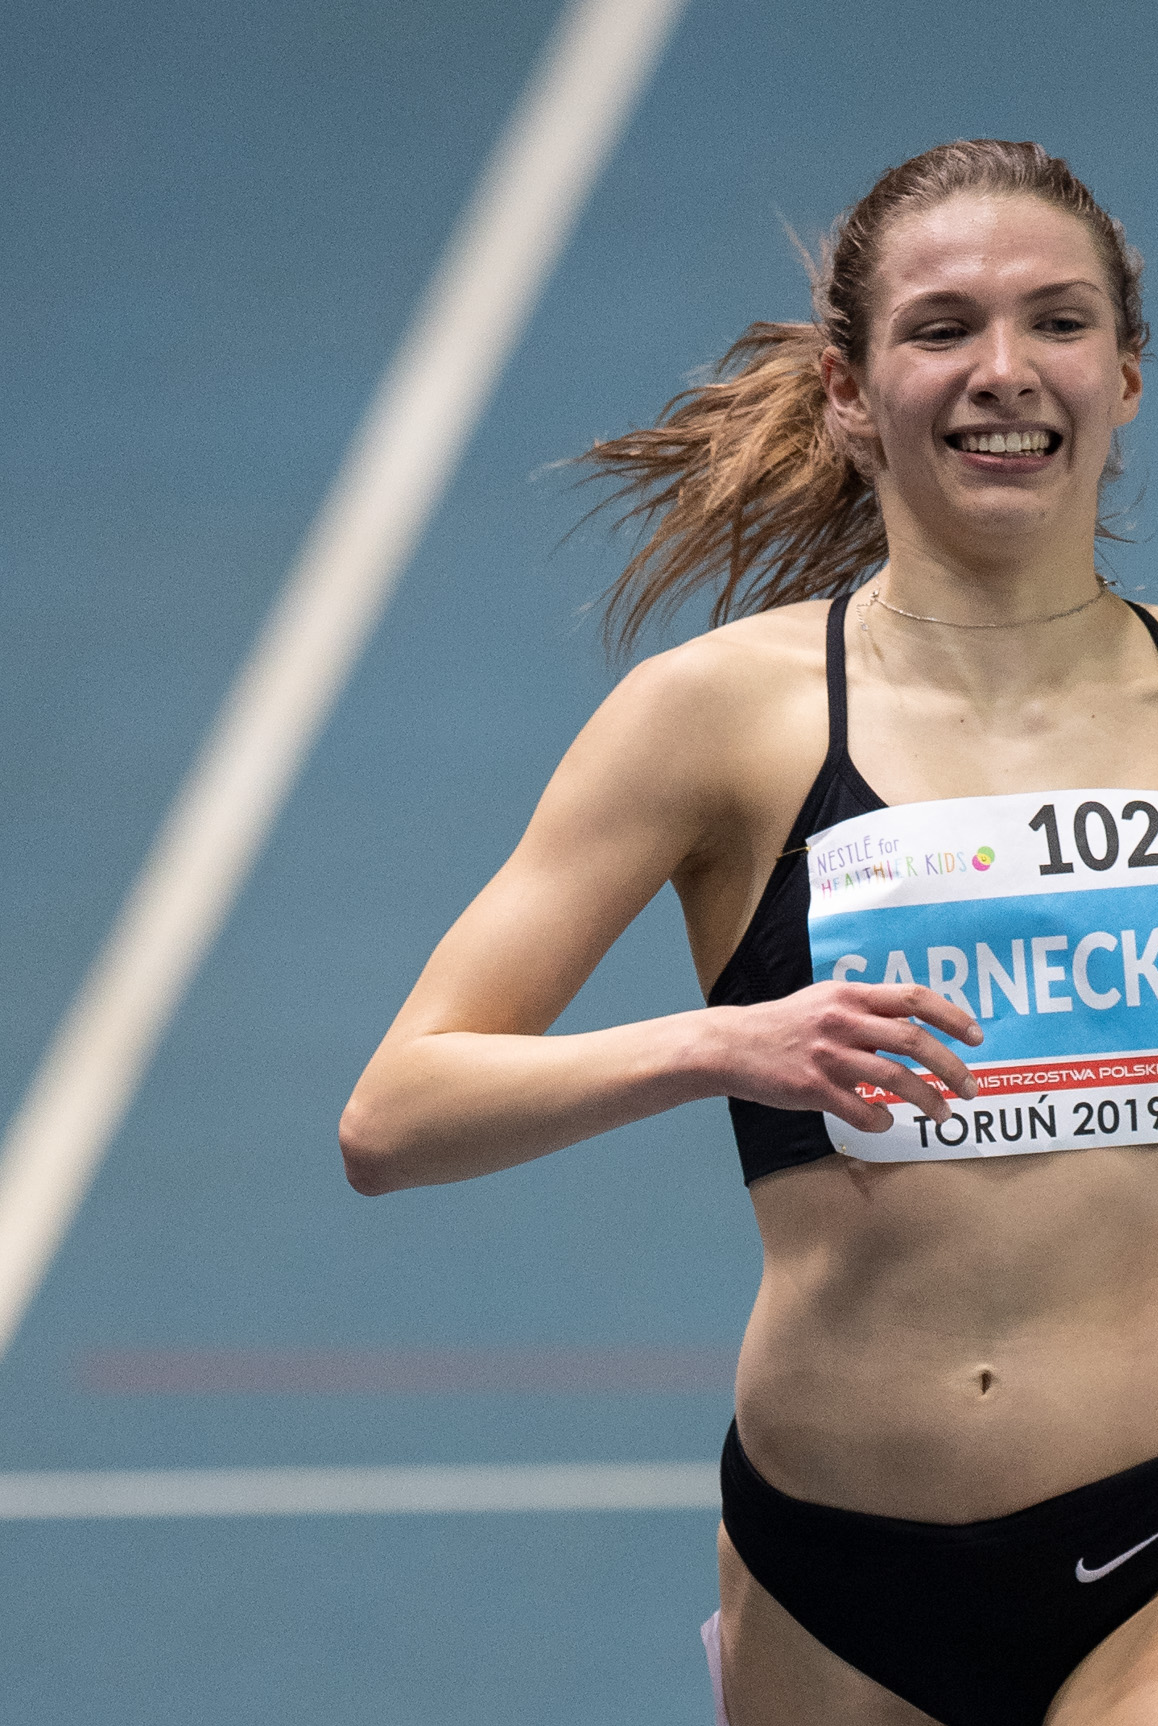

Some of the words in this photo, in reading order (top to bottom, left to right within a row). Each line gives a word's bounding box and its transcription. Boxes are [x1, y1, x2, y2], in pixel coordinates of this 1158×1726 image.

[879, 839, 899, 856] for
[924, 851, 967, 876] KIDS
[913, 1094, 1057, 1148] TORUŃ
